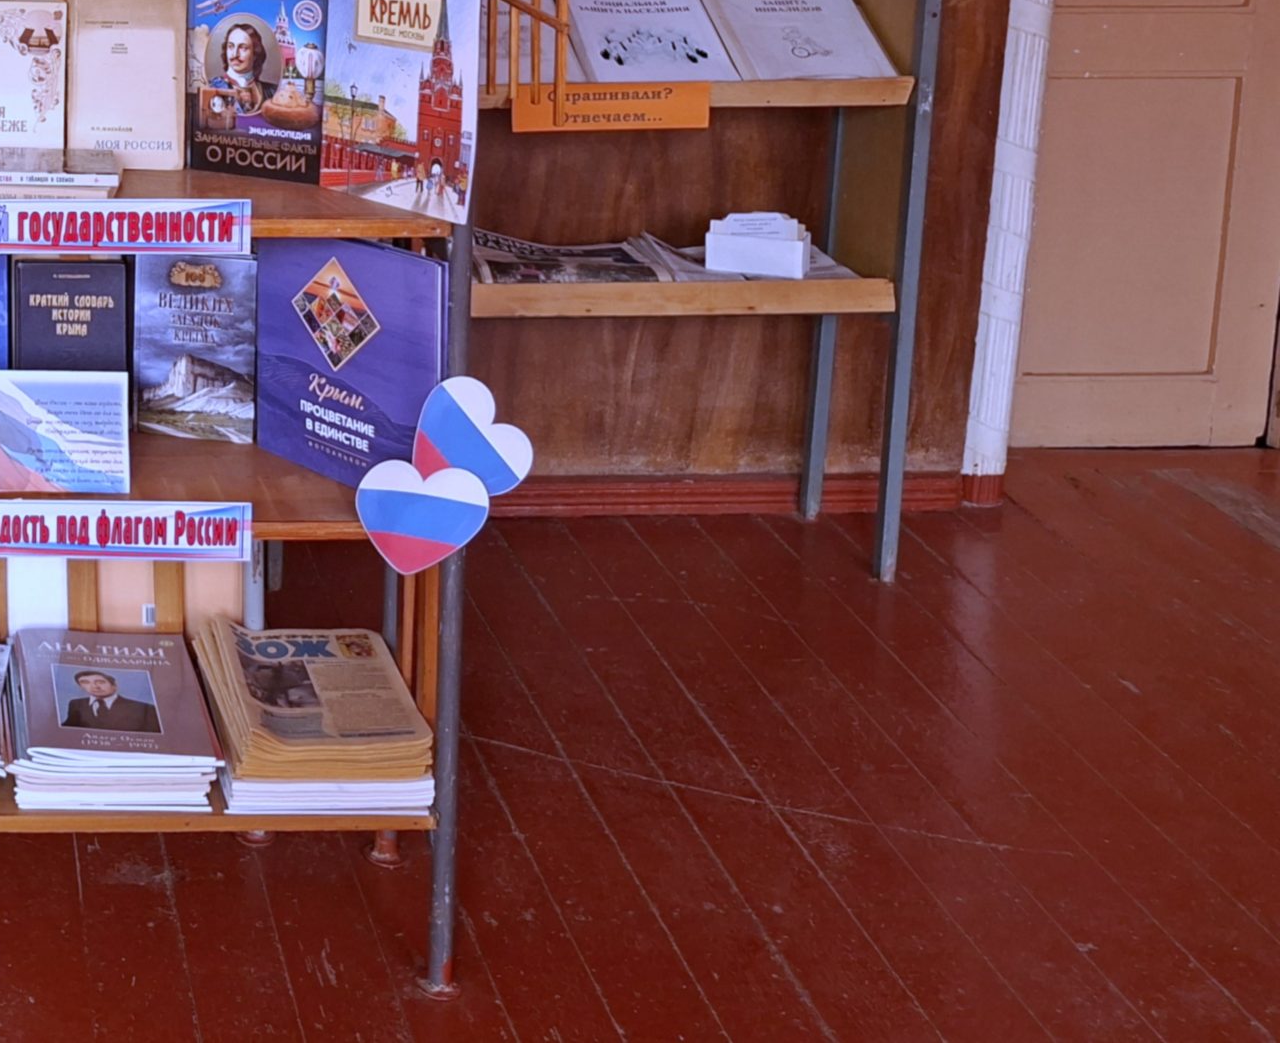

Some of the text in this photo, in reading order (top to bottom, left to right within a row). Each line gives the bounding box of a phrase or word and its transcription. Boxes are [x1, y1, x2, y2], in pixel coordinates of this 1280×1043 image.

[547, 87, 673, 105] Срашивали?
[194, 131, 317, 155] ЗАНИМАТЕЛЬНЫЕ ФАКТЫ
[248, 126, 313, 141] ЭНЦИКЛОПЕДИЯ
[94, 140, 173, 151] МОЯ РОССИЯ
[206, 146, 306, 173] О РОССИИ
[17, 209, 234, 247] государственности
[29, 292, 115, 308] КРАТКИЙ СЛОВАРЬ
[52, 309, 91, 321] ИСТОРИИ
[56, 323, 88, 337] КРЫМА
[300, 400, 375, 437] ПРОЦВЕТАНИЕ
[305, 418, 369, 452] В ЕДИНСТВЕ
[56, 515, 90, 546] под
[96, 509, 168, 548] флагом
[174, 510, 237, 546] России
[234, 637, 337, 659] ЗОЖ
